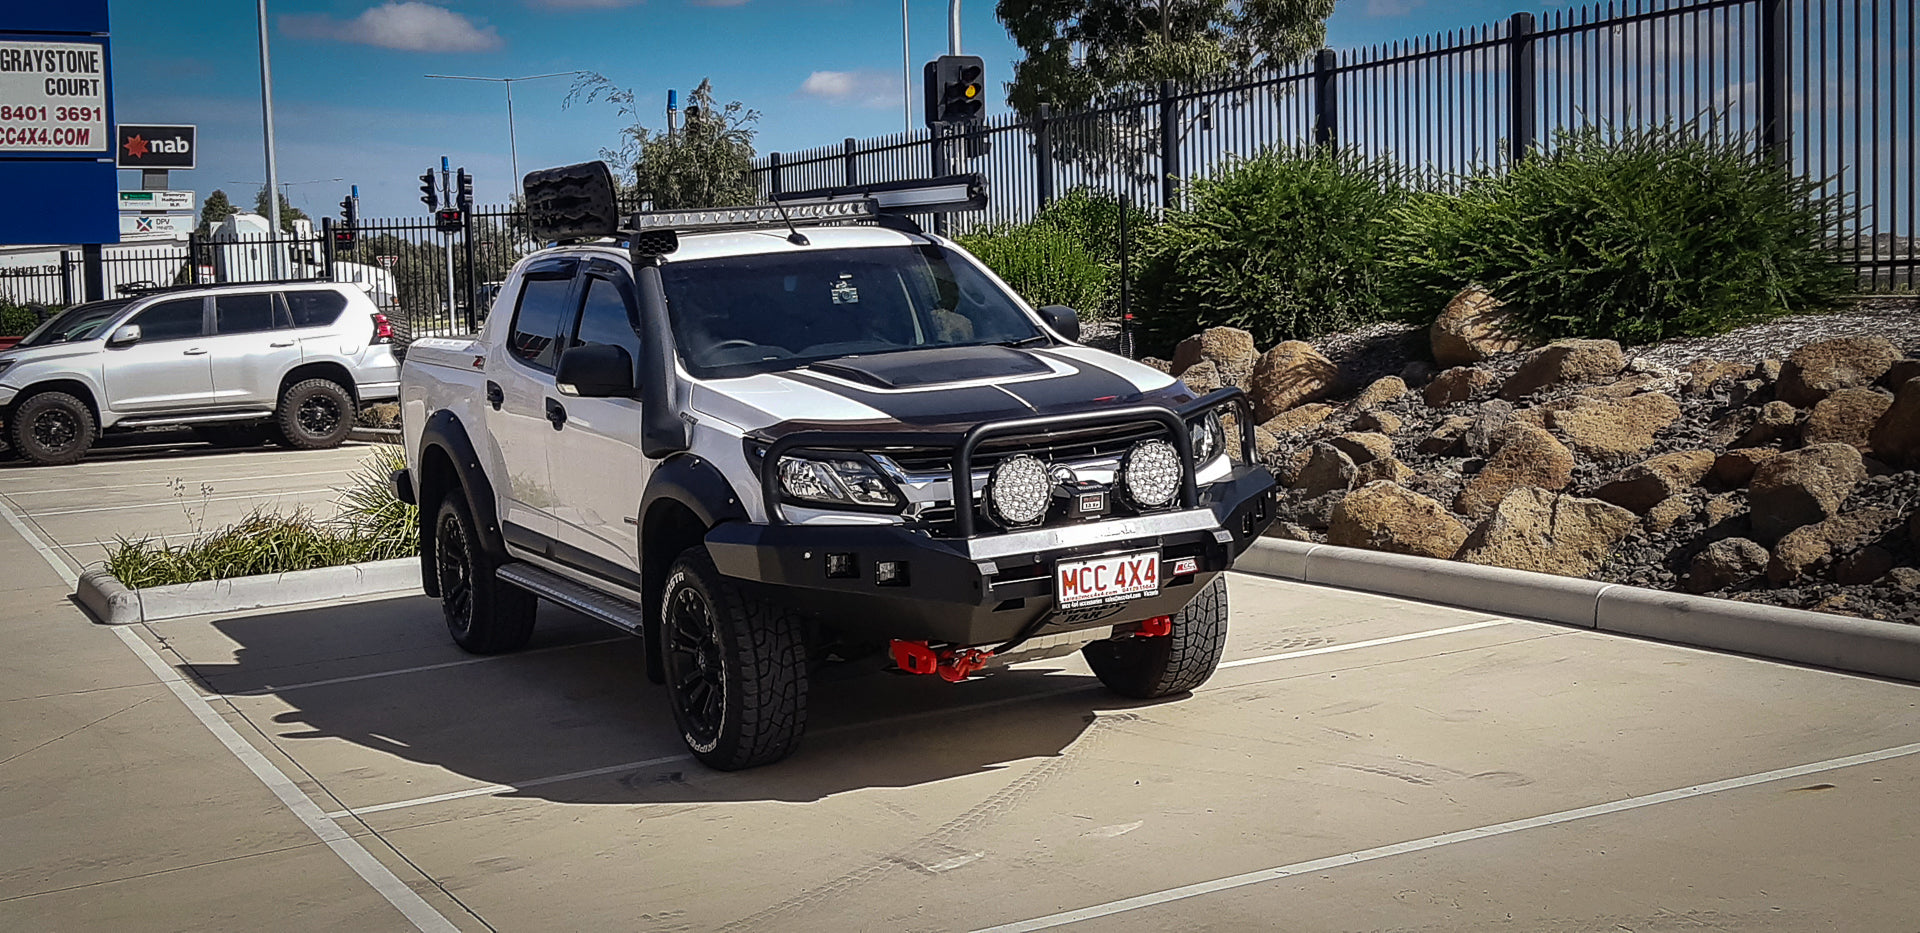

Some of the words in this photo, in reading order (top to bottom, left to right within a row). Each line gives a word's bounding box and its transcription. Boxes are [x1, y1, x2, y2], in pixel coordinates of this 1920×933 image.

[0, 49, 99, 73] GRAYSTONE
[45, 78, 99, 96] COURT
[1, 106, 47, 121] 8401
[56, 107, 101, 121] 3691
[151, 136, 190, 154] nab
[1062, 565, 1107, 597] MCC
[1115, 557, 1156, 588] 4X4
